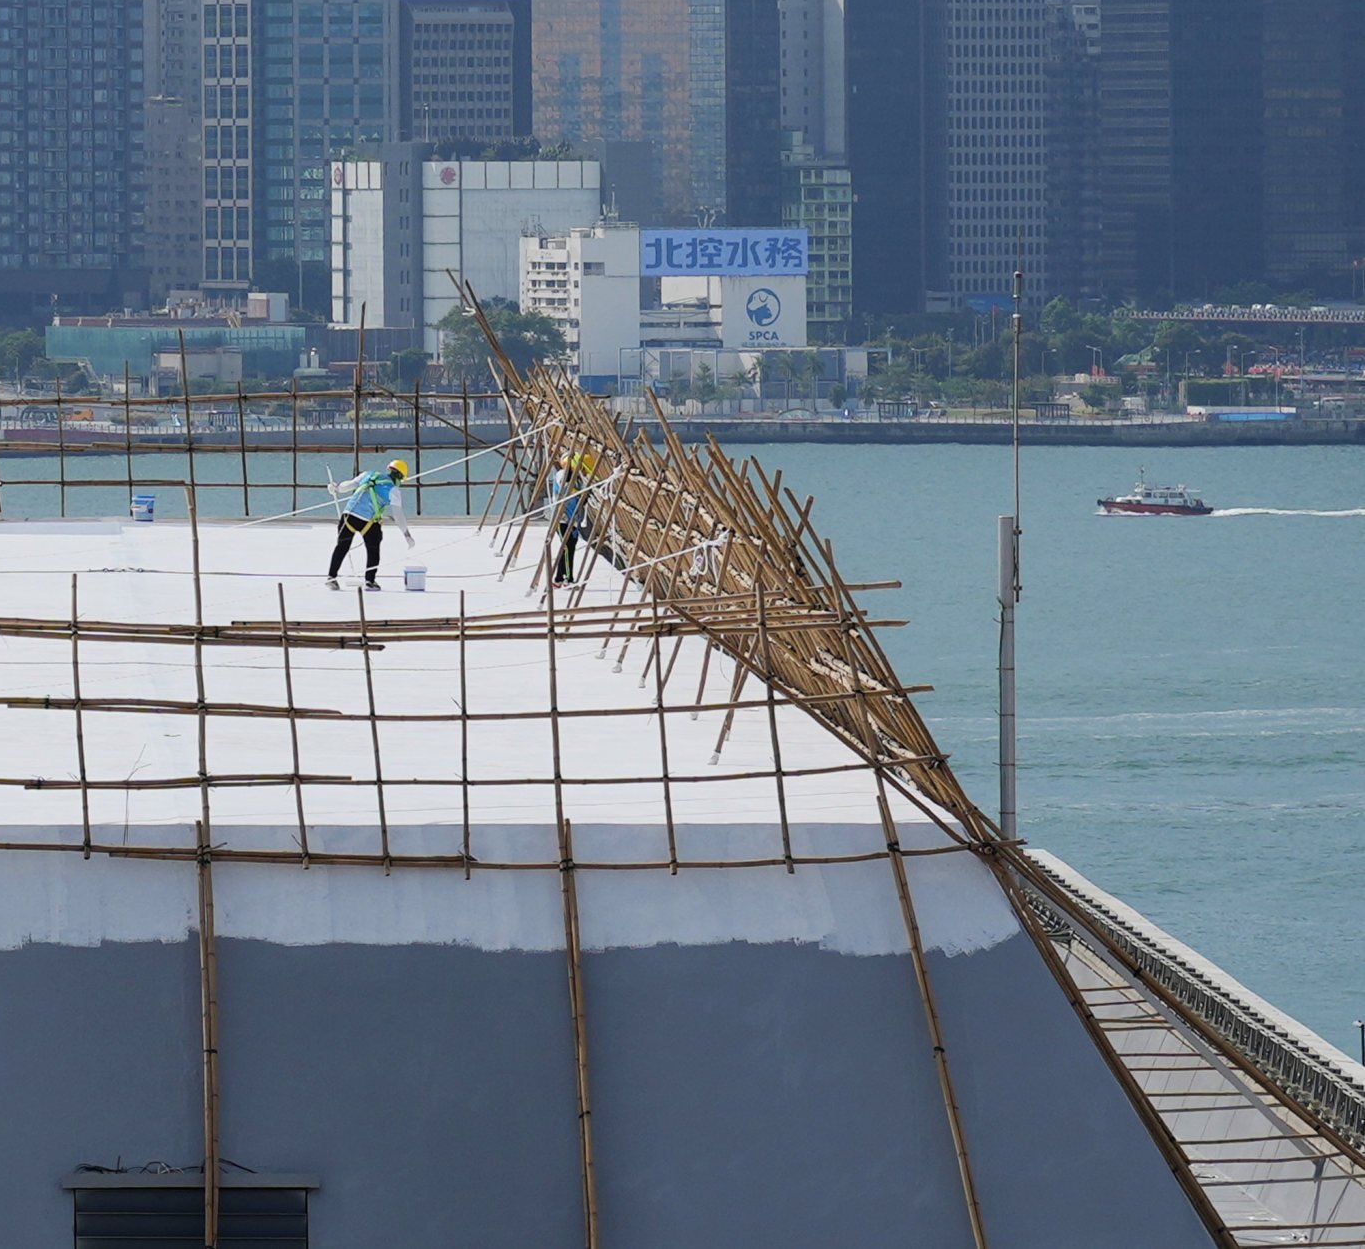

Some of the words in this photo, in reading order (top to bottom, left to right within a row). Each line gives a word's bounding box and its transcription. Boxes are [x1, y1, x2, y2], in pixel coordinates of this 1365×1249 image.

[645, 237, 803, 269] 北控水務
[749, 331, 779, 341] SPCA
